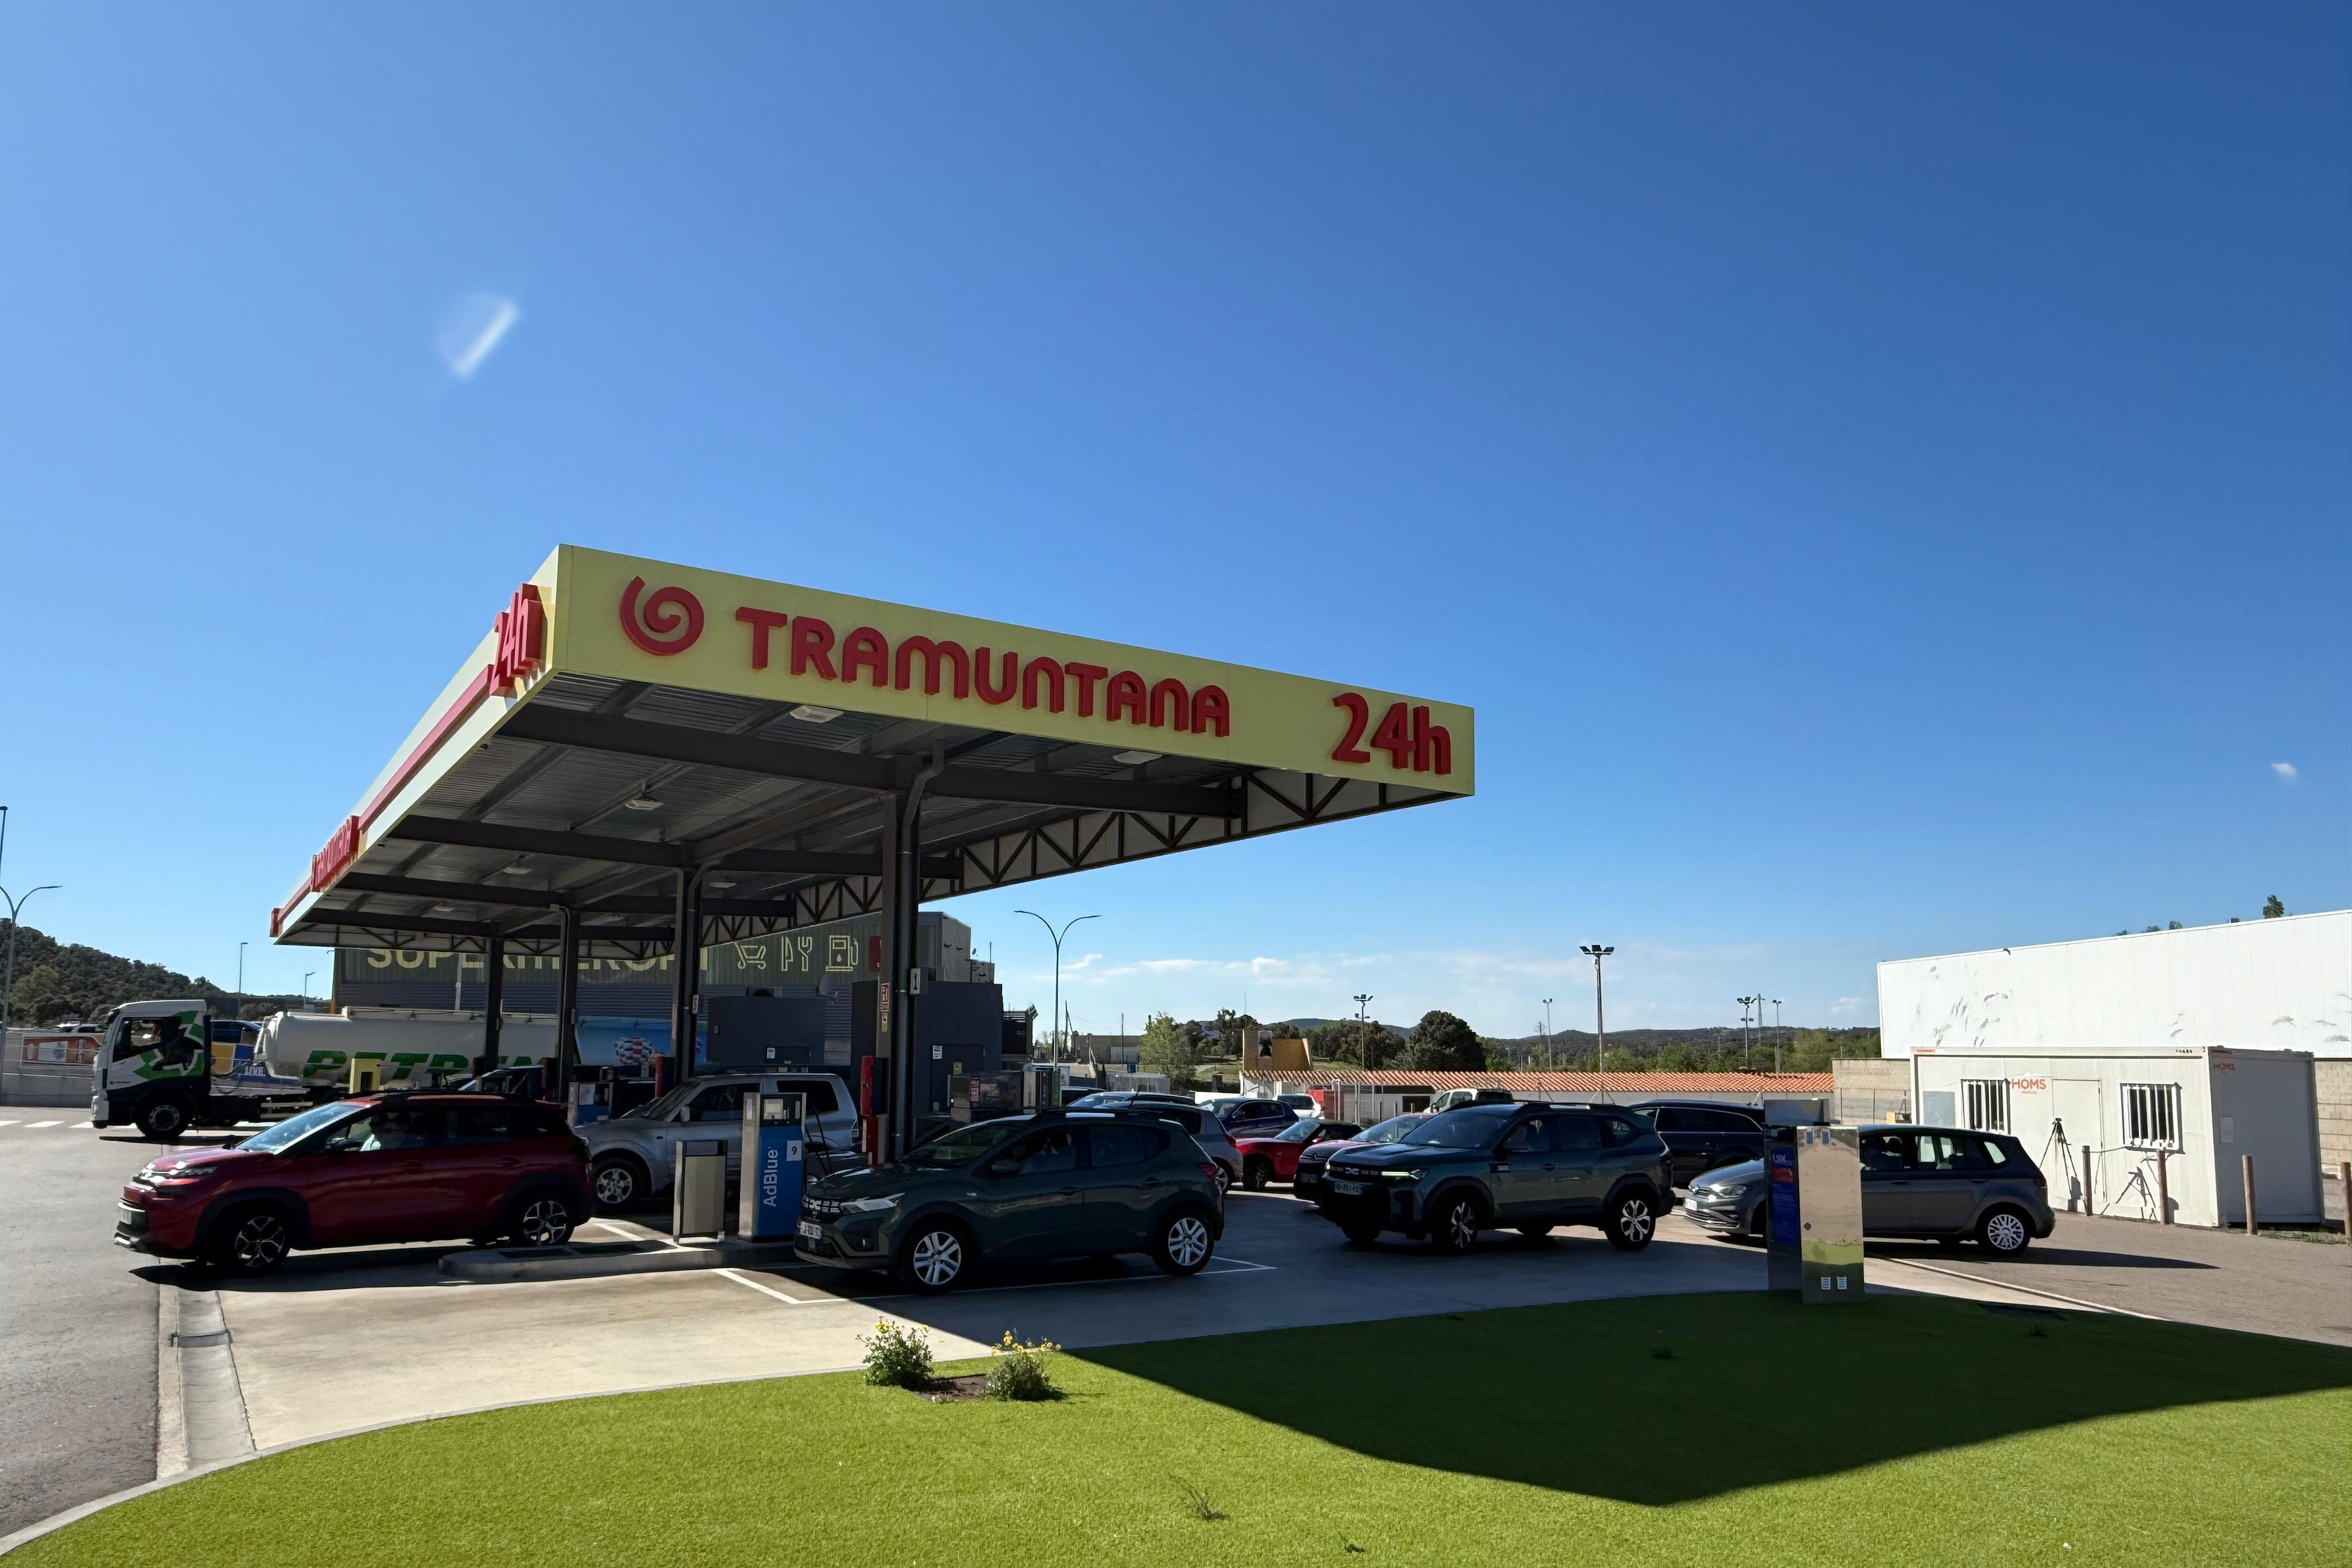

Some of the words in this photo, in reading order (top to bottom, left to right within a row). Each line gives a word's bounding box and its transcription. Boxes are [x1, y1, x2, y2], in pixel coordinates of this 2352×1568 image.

[489, 583, 541, 696] 24h
[736, 606, 1230, 738] TRAMUNTANA
[1332, 692, 1451, 775] 24h
[2012, 1079, 2046, 1090] HOMS
[763, 1149, 778, 1207] AdBlue
